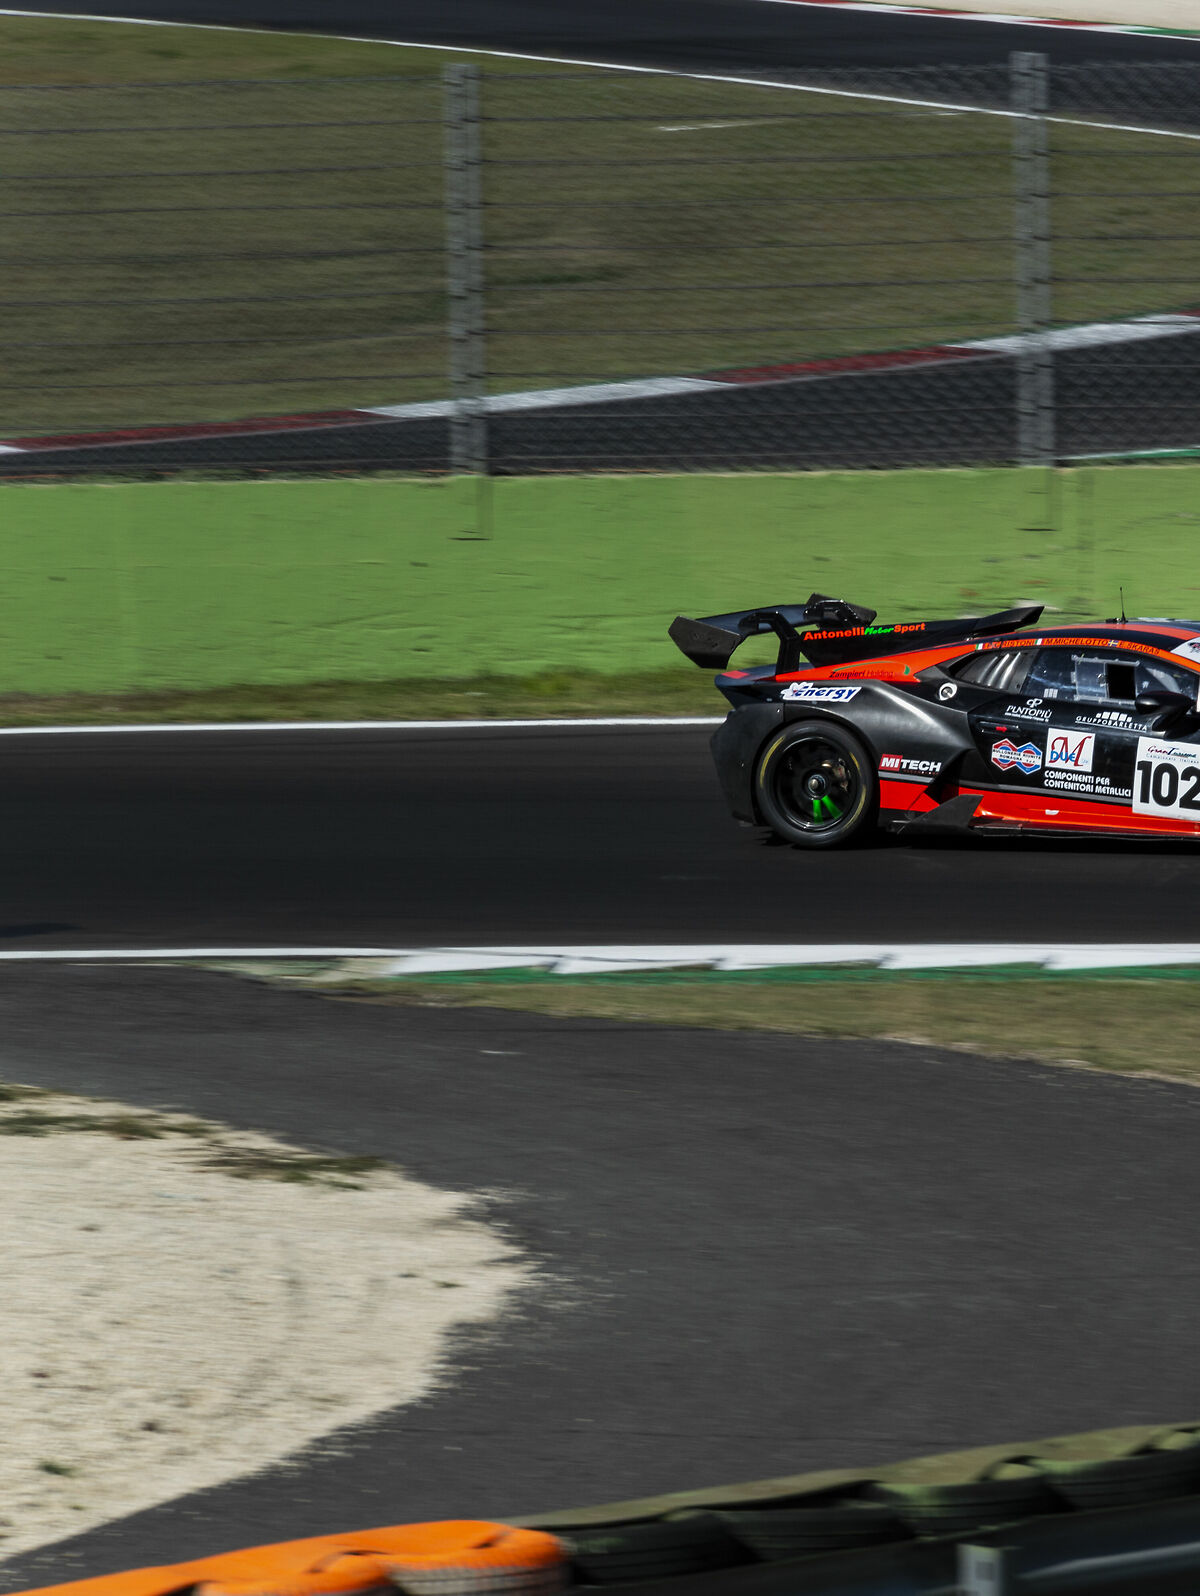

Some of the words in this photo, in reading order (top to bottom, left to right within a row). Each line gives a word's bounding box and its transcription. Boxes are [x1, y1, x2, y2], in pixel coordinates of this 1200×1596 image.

[794, 684, 857, 699] Energy
[1076, 716, 1147, 731] GRUPPOBARLETTA
[1050, 750, 1077, 762] DUE
[1044, 770, 1094, 783] COMPONENTI
[1095, 776, 1110, 785] PER
[1044, 779, 1094, 793] CONTENITORI
[1094, 785, 1132, 797] METALLICI
